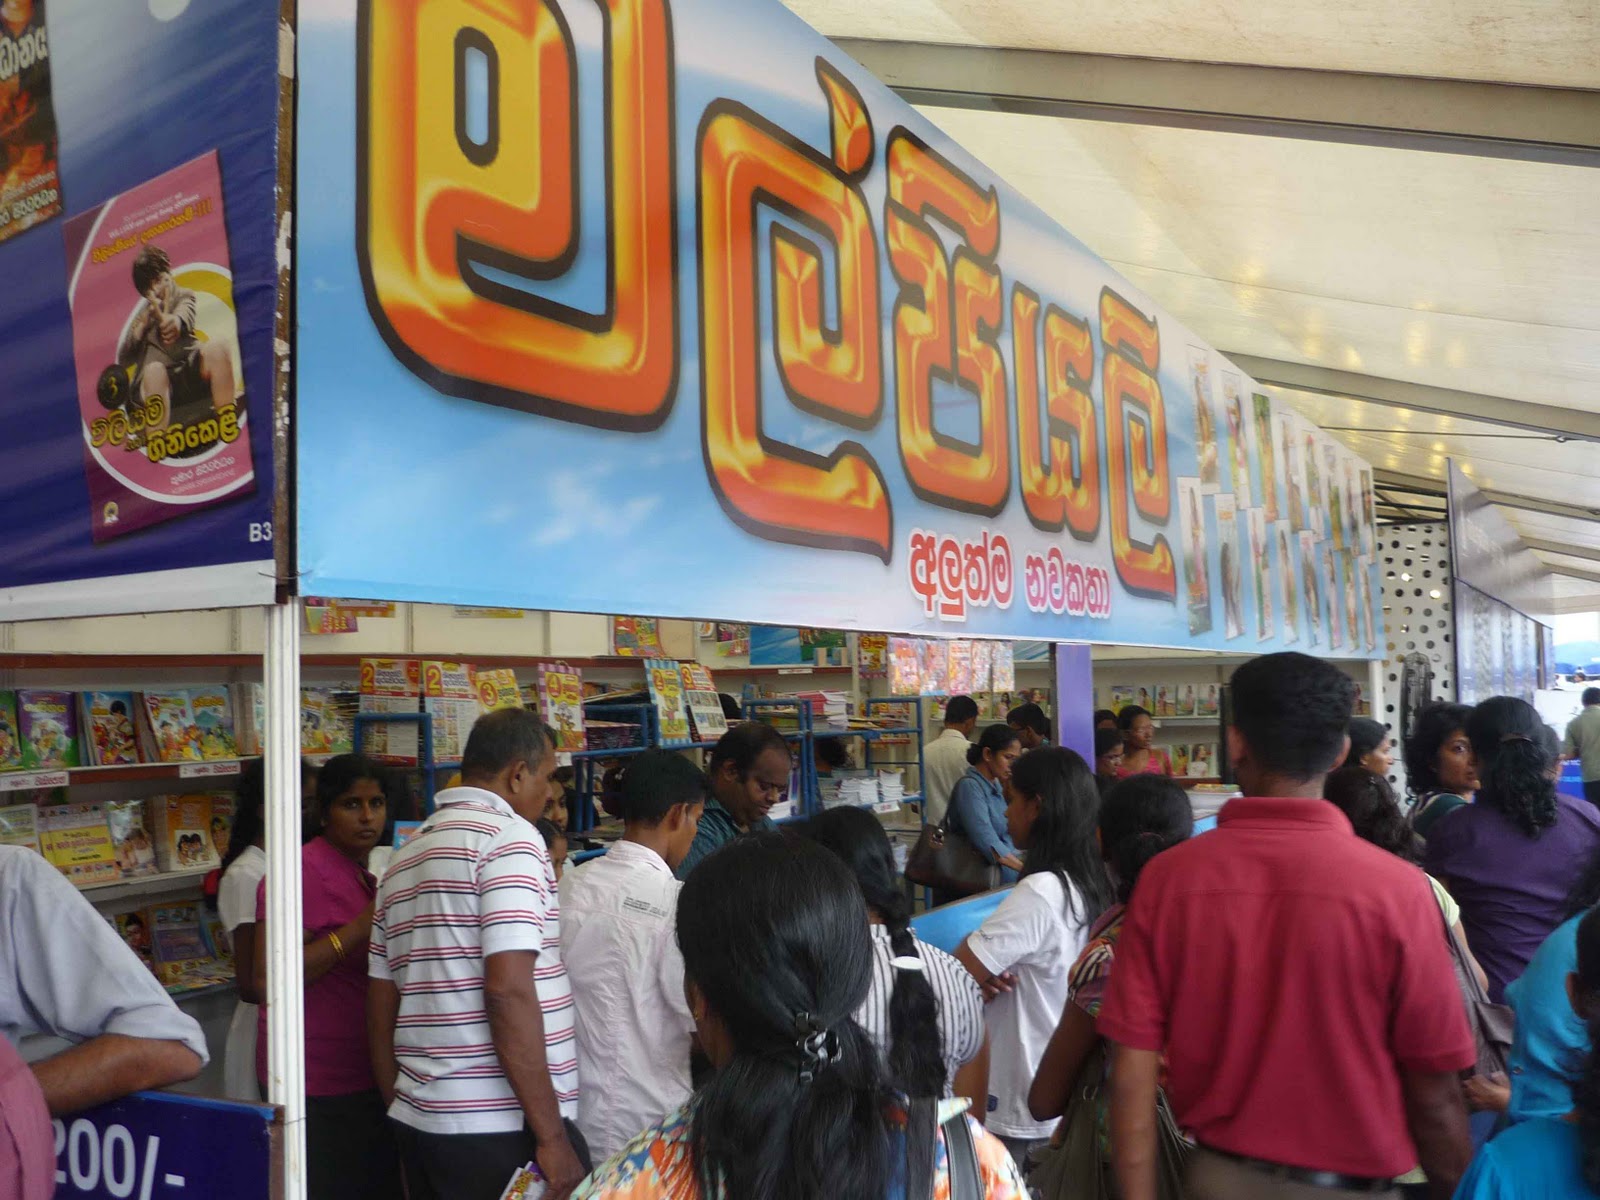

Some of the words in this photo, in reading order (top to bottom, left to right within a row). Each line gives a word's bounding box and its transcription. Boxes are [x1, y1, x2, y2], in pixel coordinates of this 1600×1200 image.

[146, 403, 240, 462] ගිනිකෙළි
[249, 522, 273, 543] B3
[910, 528, 1014, 618] අලුත්ම
[1024, 546, 1111, 615] නවකතා
[360, 666, 374, 687] 2
[426, 668, 441, 689] 2
[483, 684, 495, 703] 3
